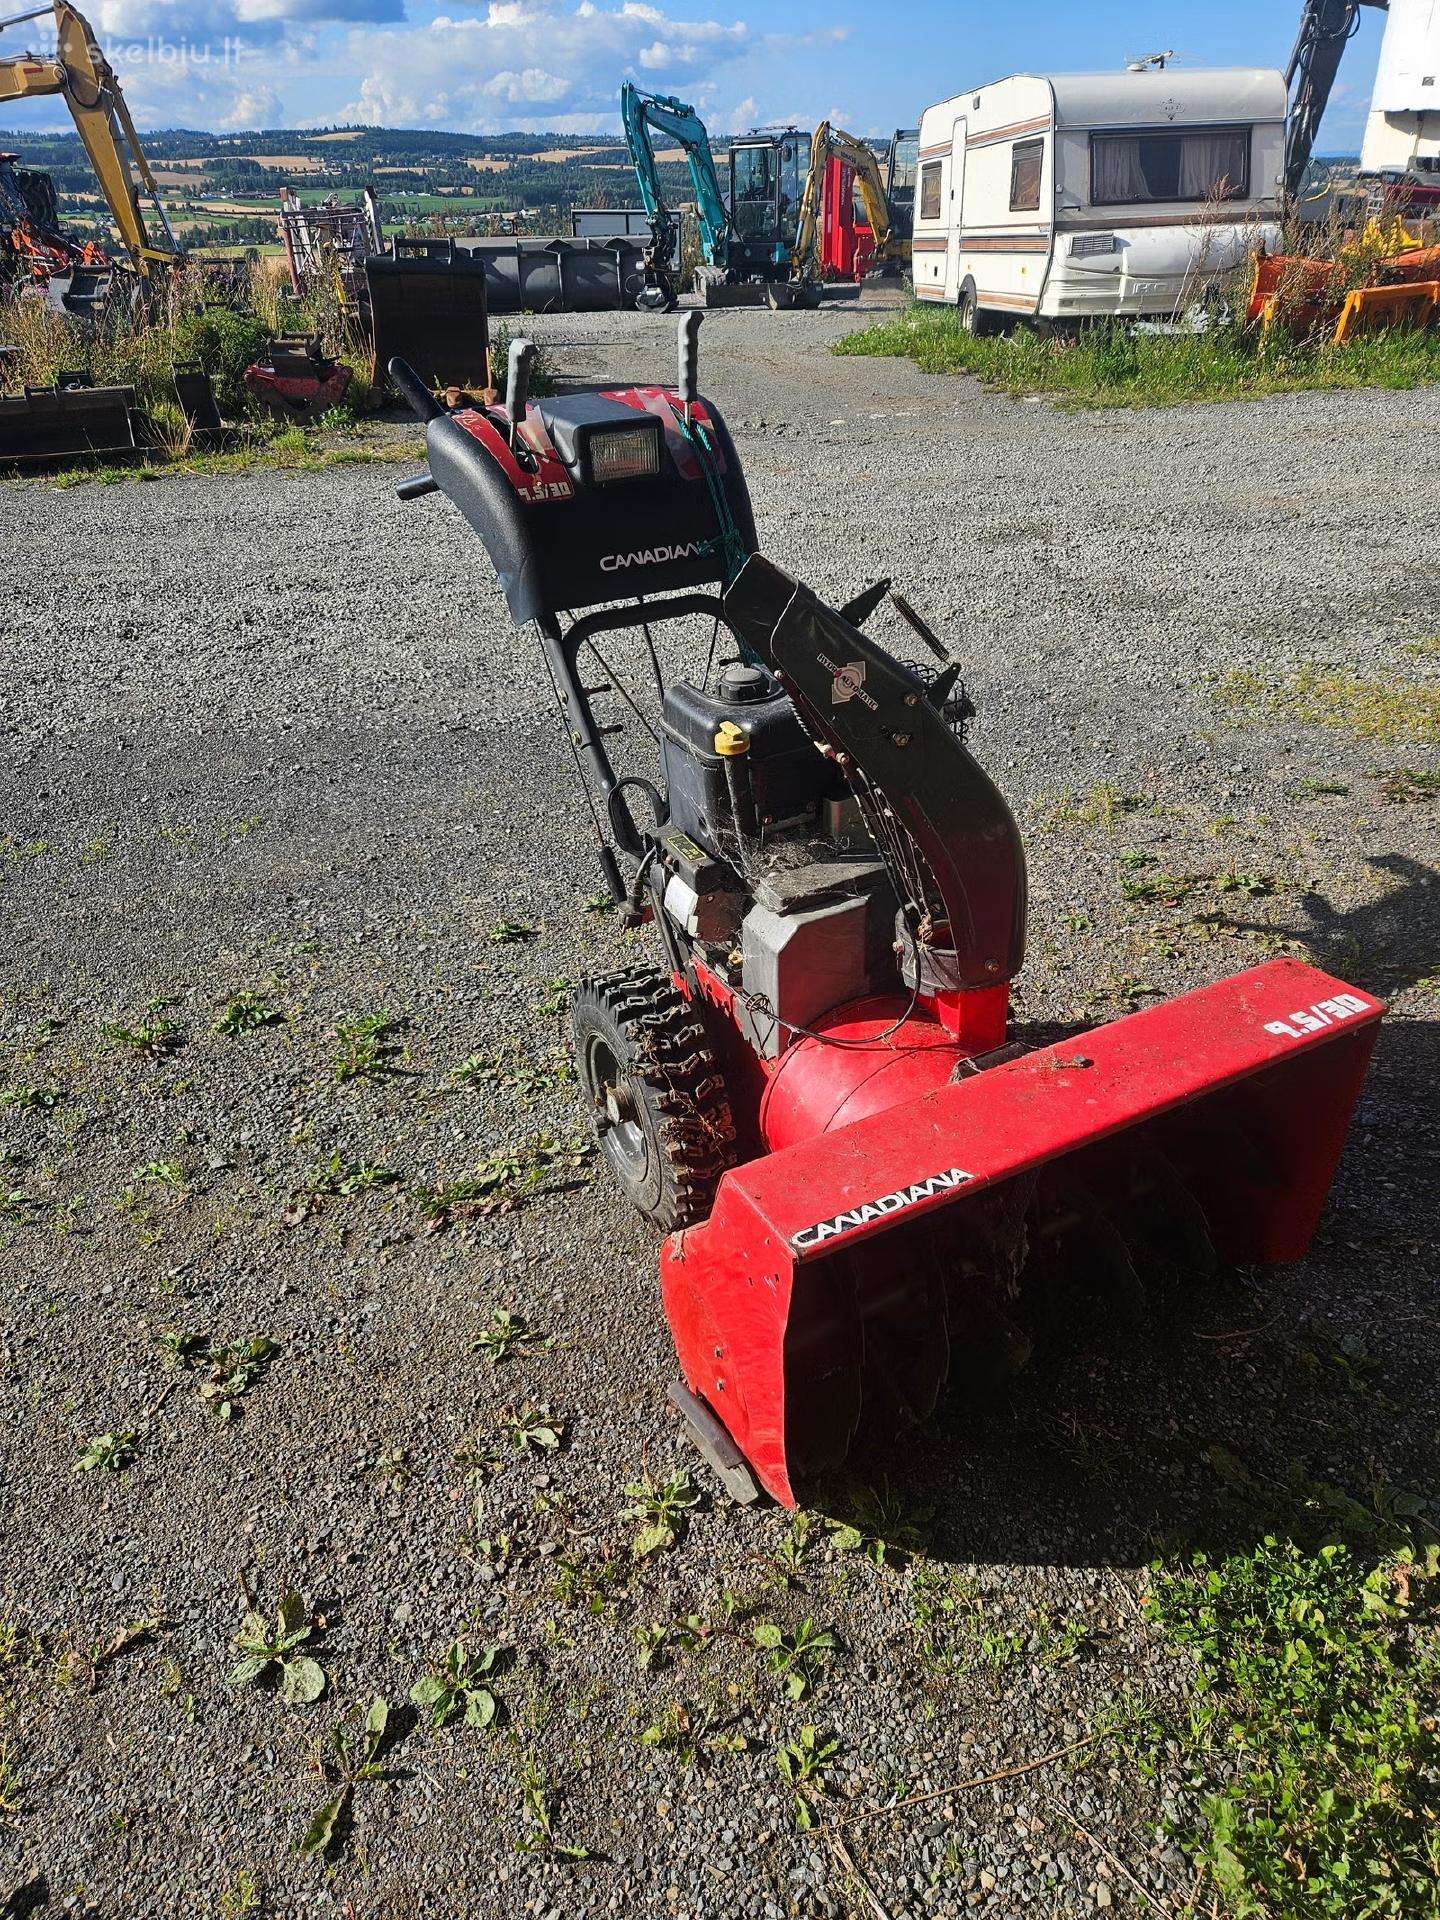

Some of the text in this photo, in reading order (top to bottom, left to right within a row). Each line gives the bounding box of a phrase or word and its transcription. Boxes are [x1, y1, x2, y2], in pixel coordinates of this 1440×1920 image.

[517, 481, 571, 501] 9.5/30
[1263, 993, 1371, 1038] 9.5/30
[790, 1167, 976, 1248] CANADIANA
